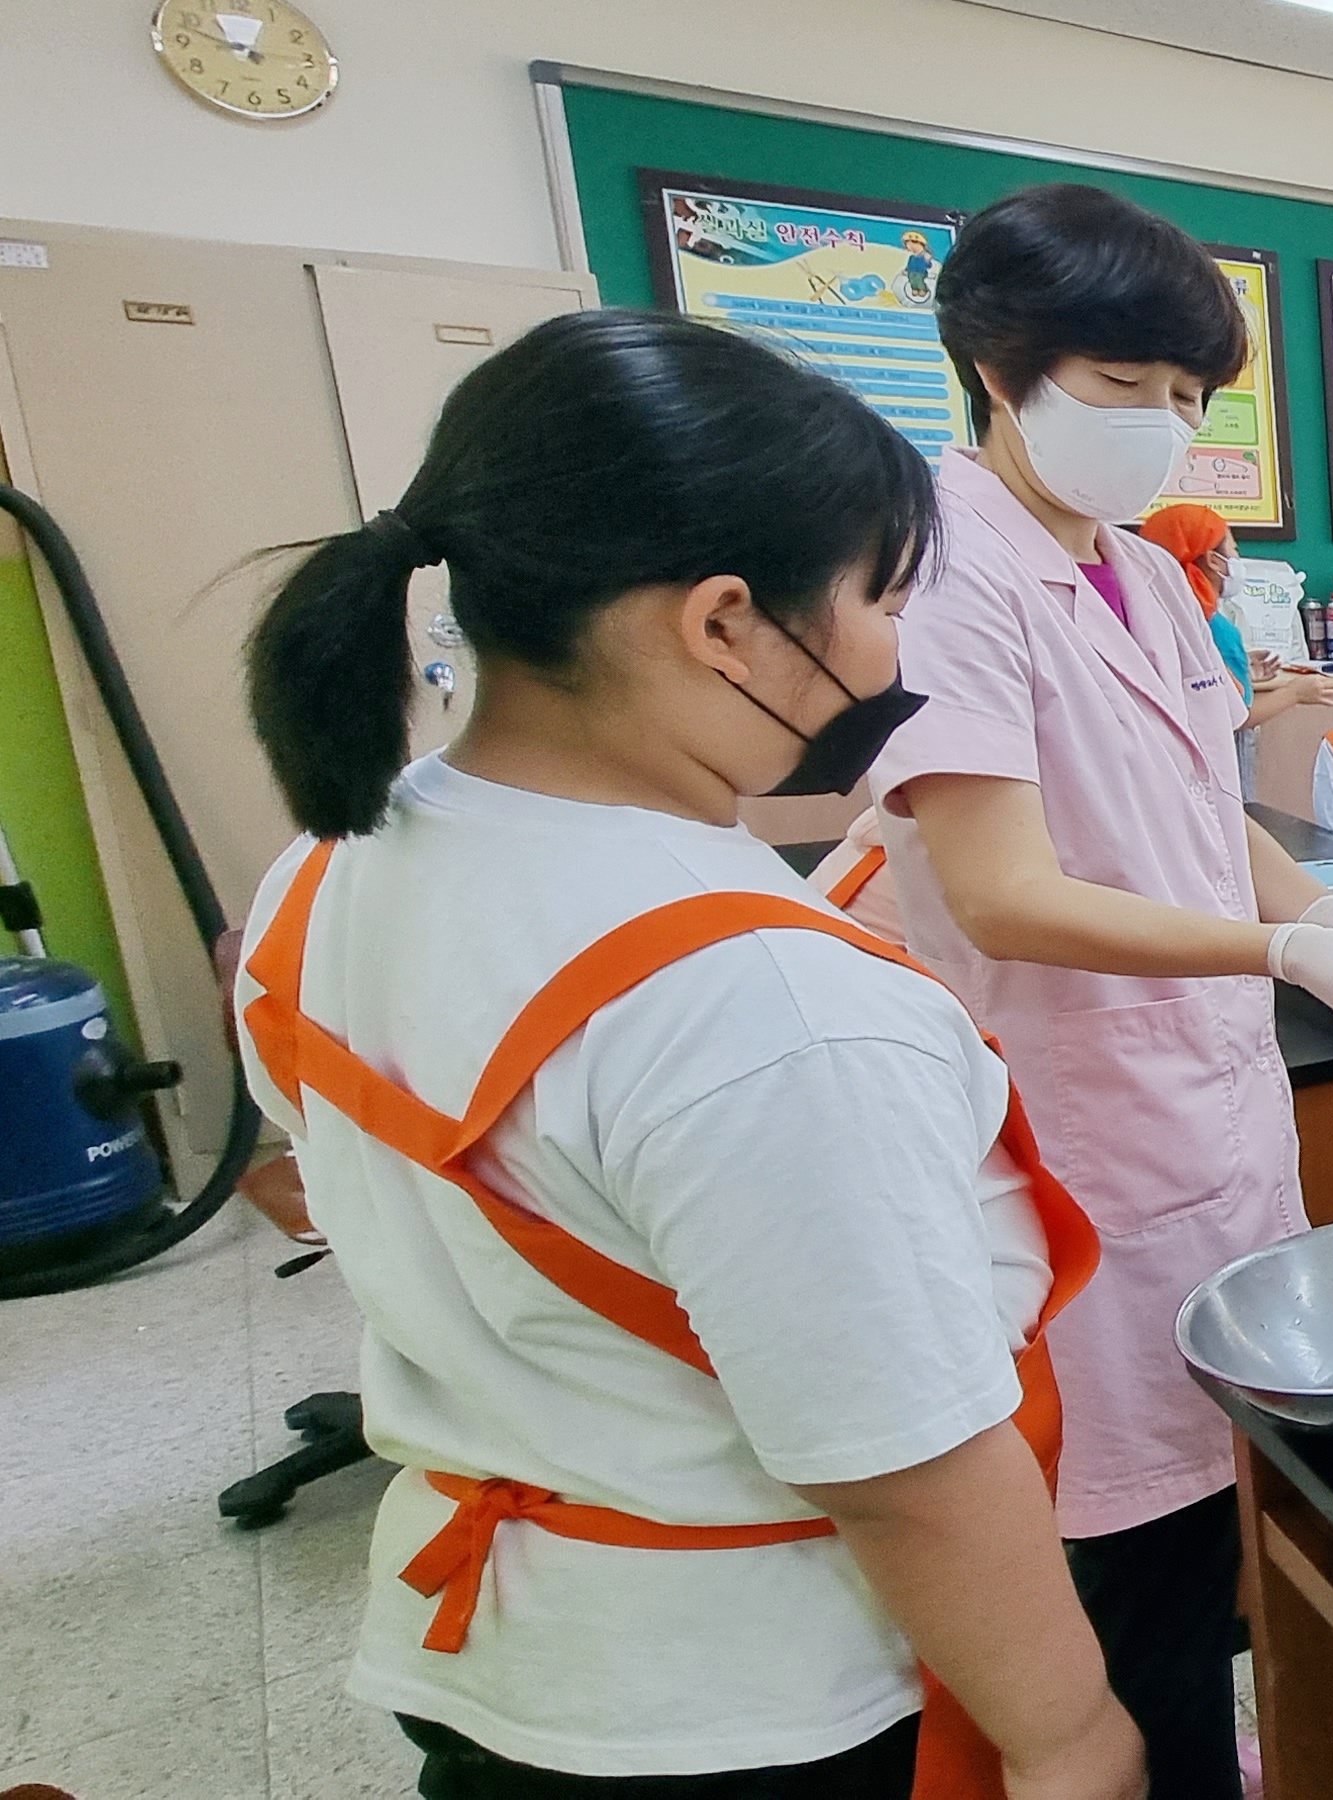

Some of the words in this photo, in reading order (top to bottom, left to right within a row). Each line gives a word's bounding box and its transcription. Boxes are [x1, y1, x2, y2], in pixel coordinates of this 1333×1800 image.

[176, 33, 190, 48] 9
[290, 29, 303, 45] 2
[190, 57, 204, 75] 8
[303, 53, 314, 69] 3
[217, 79, 231, 96] 7
[296, 75, 309, 90] 4
[248, 91, 262, 106] 6
[277, 88, 291, 104] 5
[775, 222, 867, 251] 안전수칙
